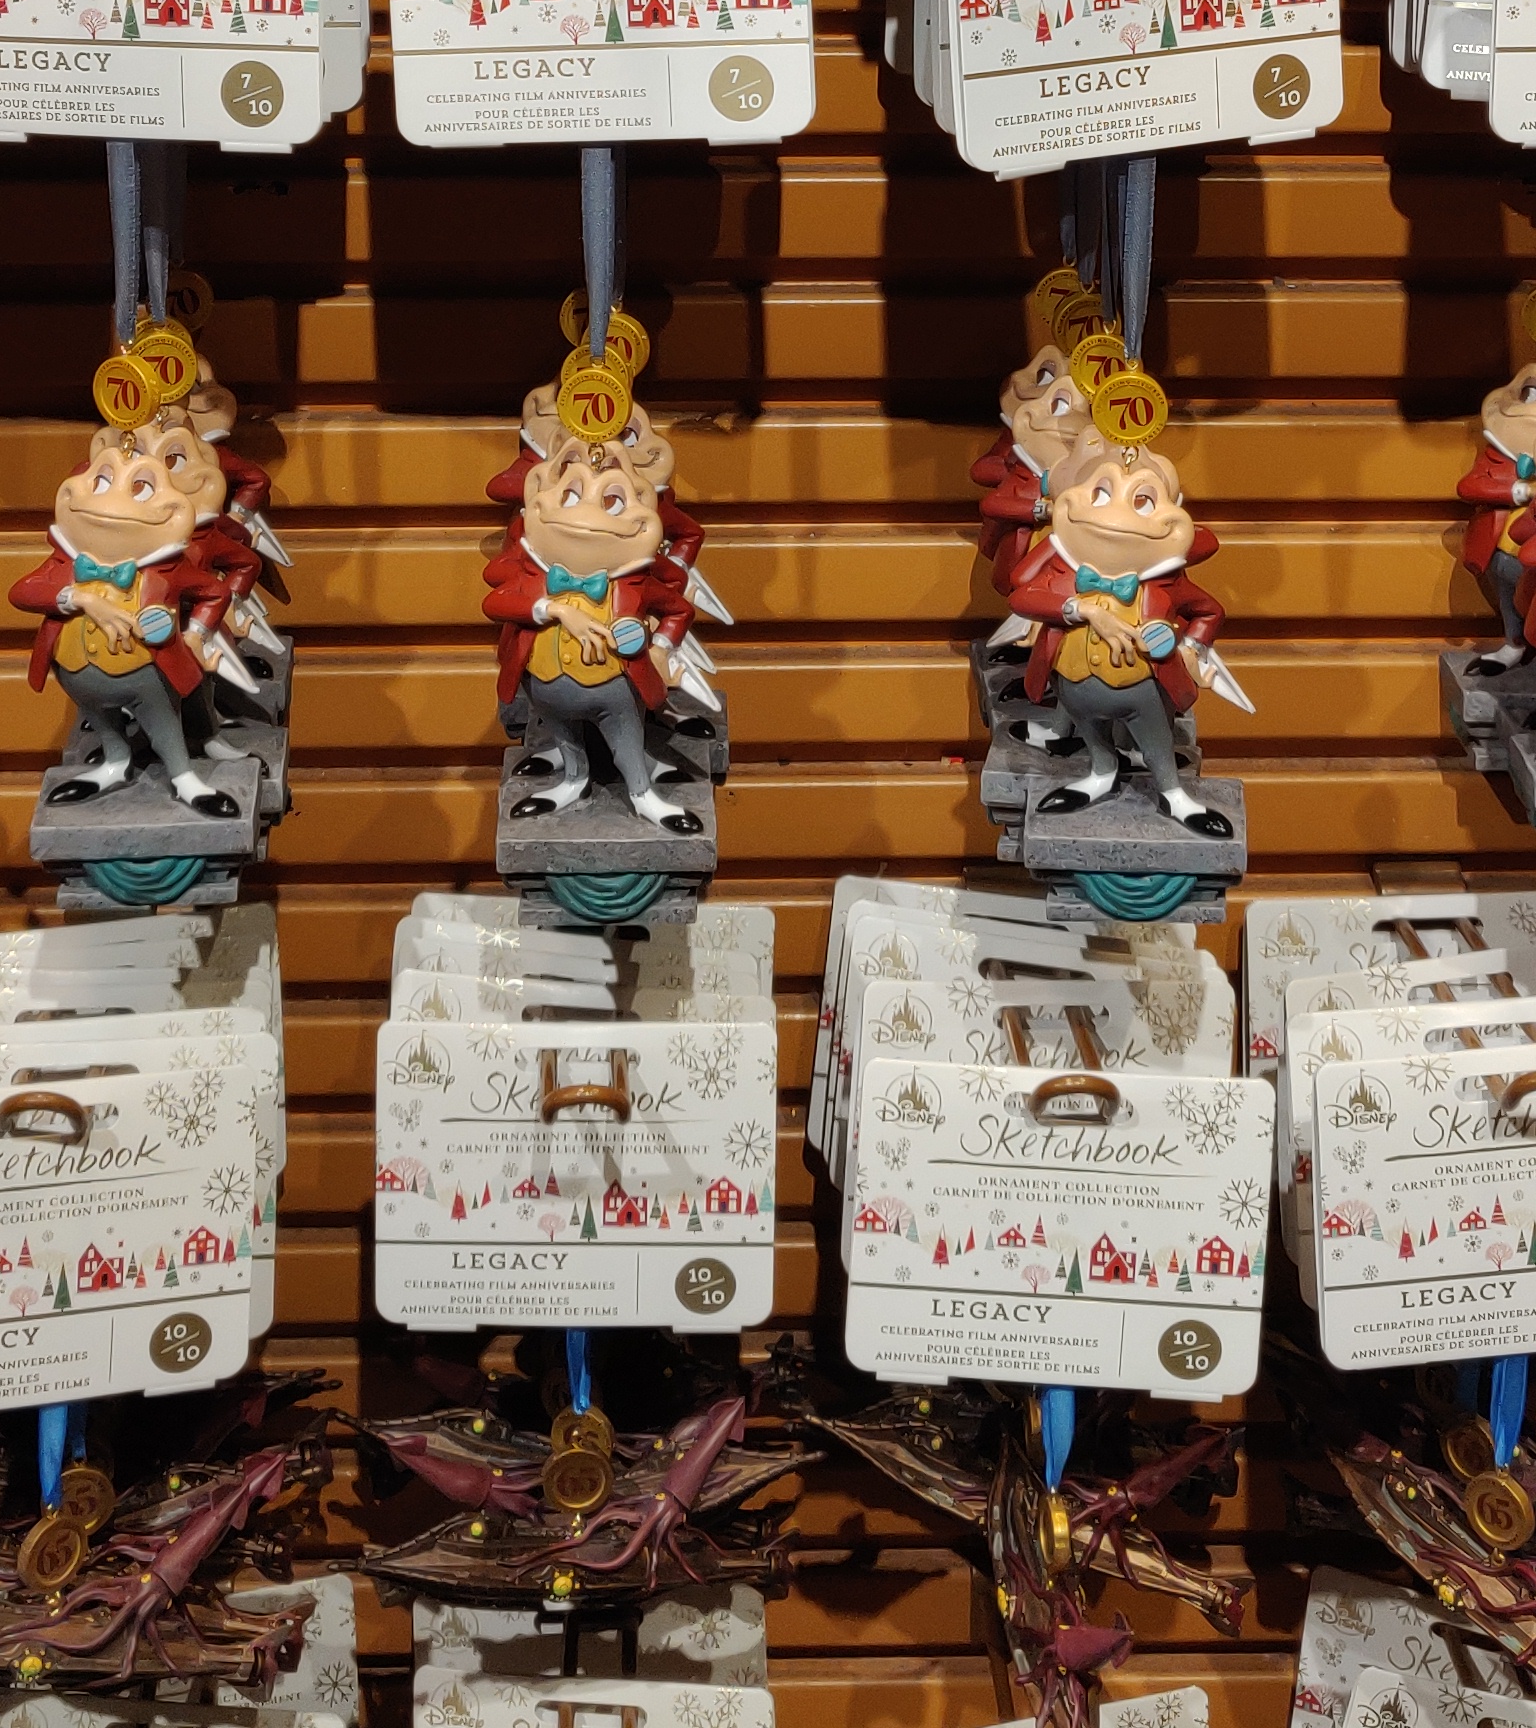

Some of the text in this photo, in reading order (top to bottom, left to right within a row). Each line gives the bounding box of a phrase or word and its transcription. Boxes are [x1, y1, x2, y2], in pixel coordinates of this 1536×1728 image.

[474, 58, 596, 81] LEGACY
[1039, 66, 1151, 98] LEGACY
[995, 93, 1197, 127] CELEBRATING FILM ANNIVERSARIES
[992, 121, 1201, 157] ANNIVERSAIRES DE SORTIE DE FILMS
[1040, 126, 1071, 139] POUR
[1135, 116, 1154, 126] LES
[106, 378, 140, 411] 70
[573, 393, 613, 425] 70
[1111, 398, 1153, 429] 70
[960, 1114, 1183, 1167] Sketchbook
[451, 1252, 569, 1270] LEGACY
[1401, 1281, 1517, 1309] LEGACY
[930, 1299, 1053, 1324] LEGACY
[1476, 1494, 1512, 1527] 65
